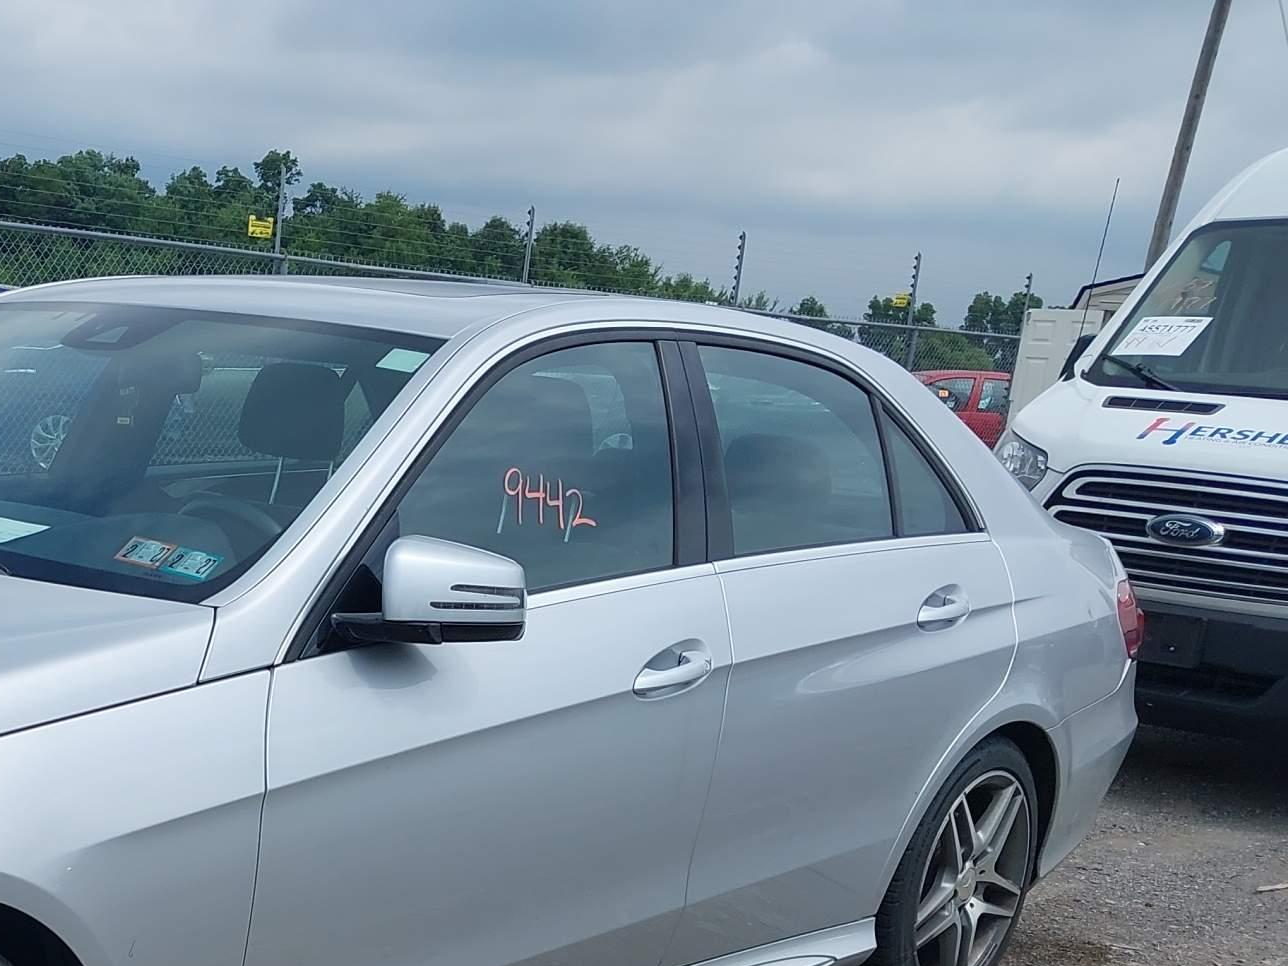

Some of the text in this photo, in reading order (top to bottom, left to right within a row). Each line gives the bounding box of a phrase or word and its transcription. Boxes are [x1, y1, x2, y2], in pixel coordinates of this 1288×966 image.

[504, 467, 597, 530] 9442
[1159, 520, 1201, 538] Ford
[122, 544, 171, 563] 2 27
[168, 553, 217, 577] 2 27
